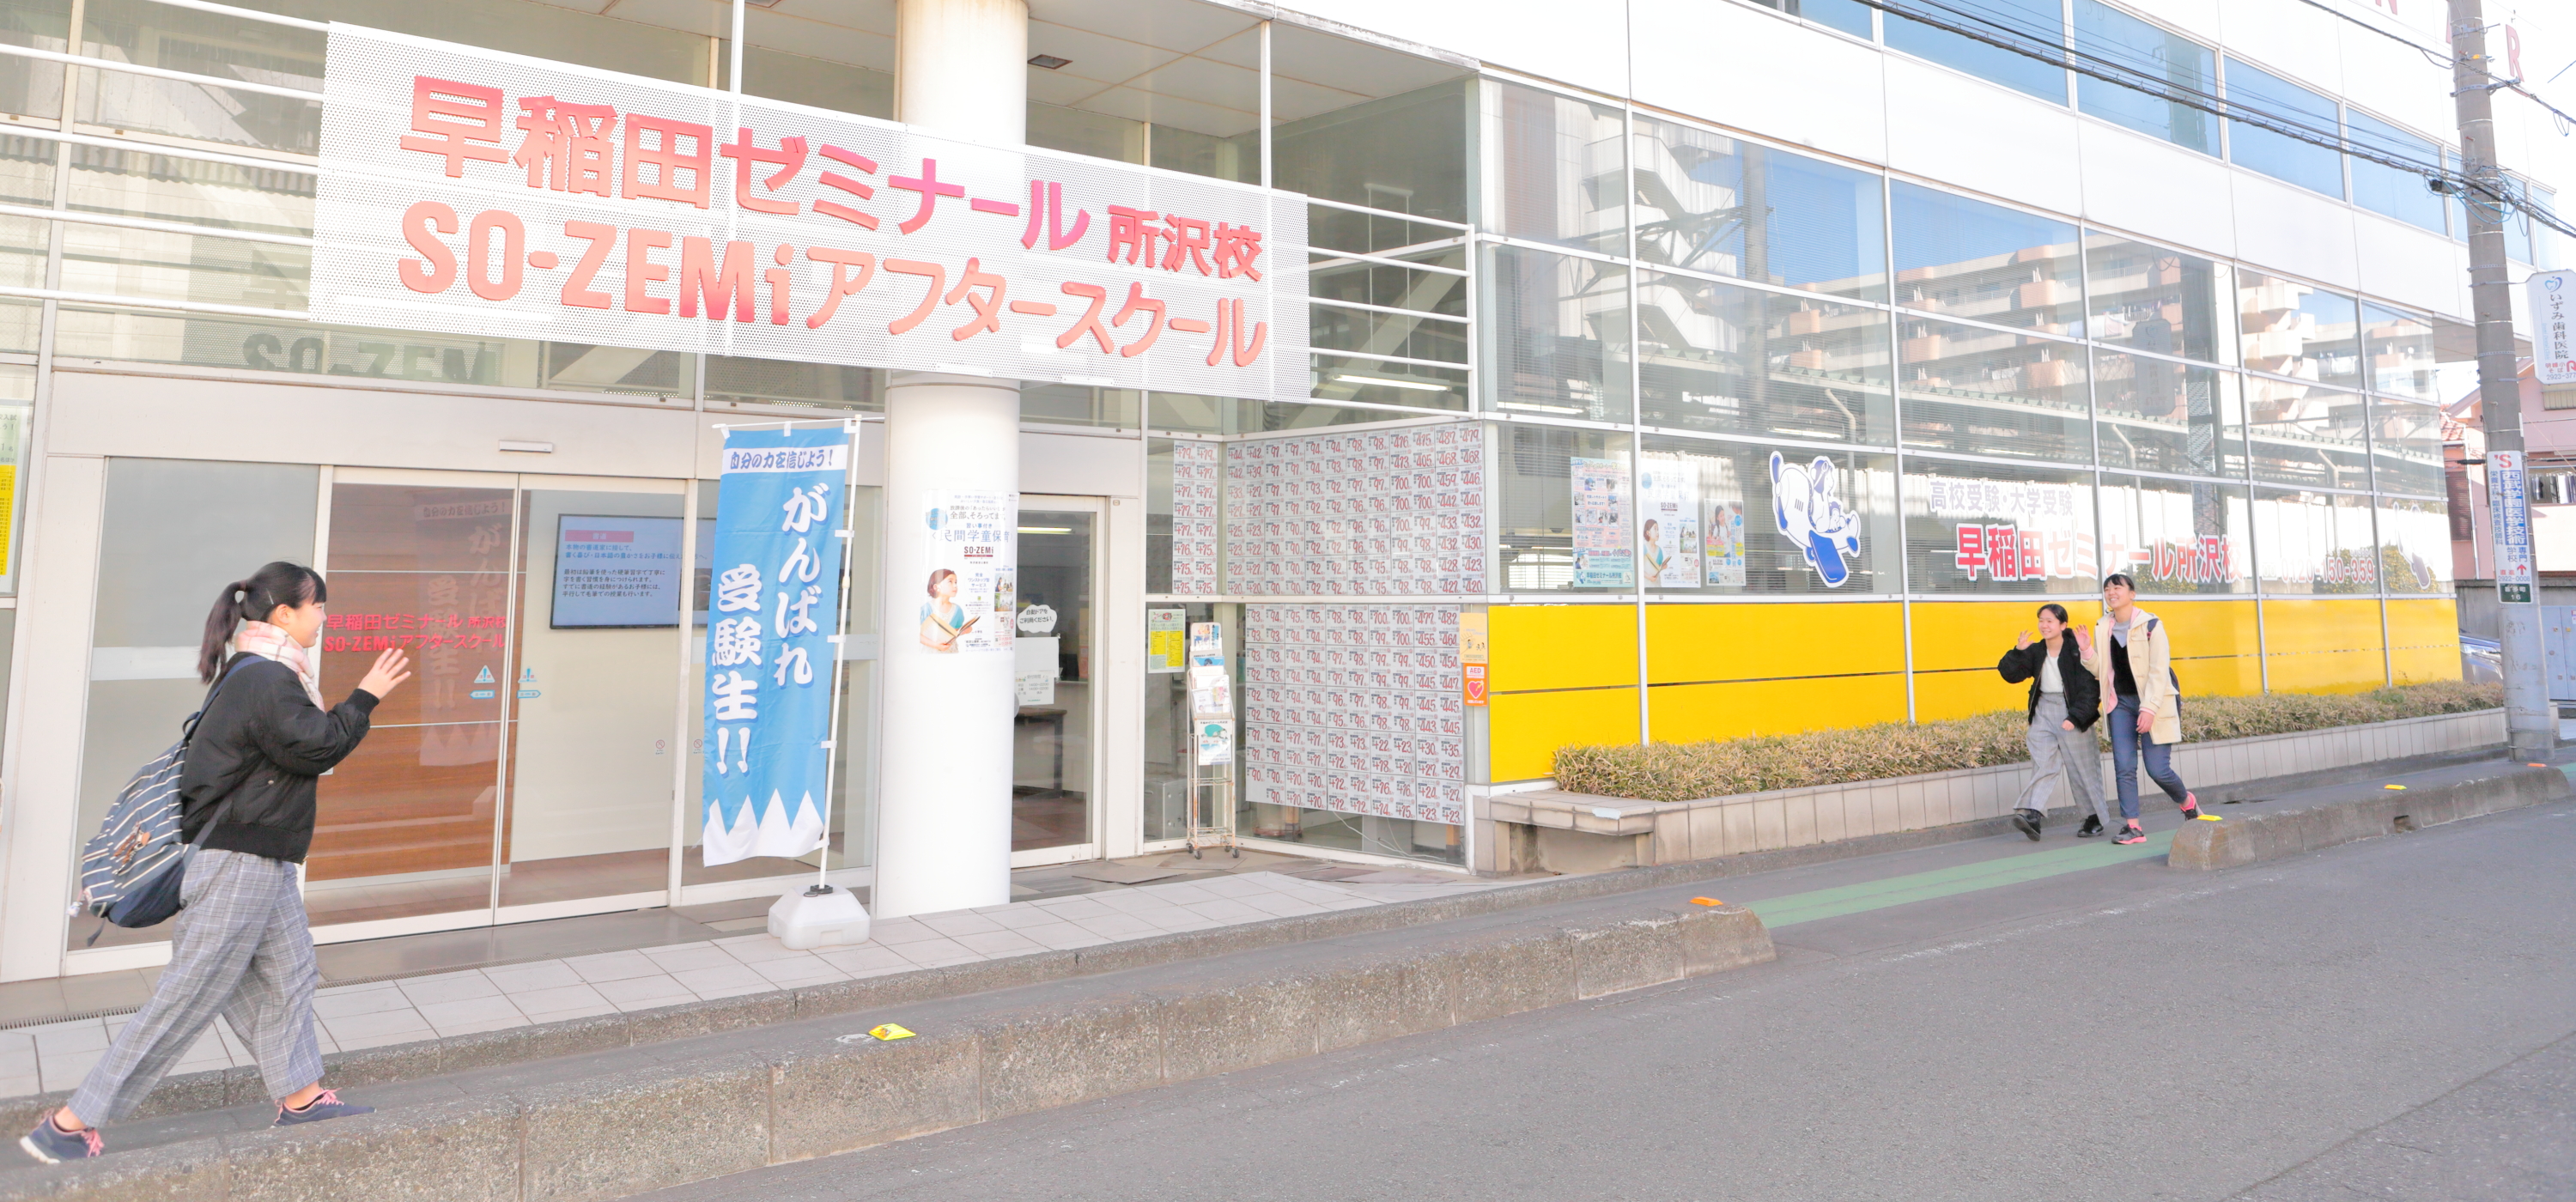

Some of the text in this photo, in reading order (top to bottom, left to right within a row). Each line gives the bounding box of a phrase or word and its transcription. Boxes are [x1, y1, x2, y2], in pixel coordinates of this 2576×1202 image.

[400, 76, 1262, 282] 早稲田ゼミナール 所沢校
[398, 201, 1267, 367] SO-ZEMiアフタースクール
[2550, 294, 2569, 360] いずみ歯科医院
[1930, 481, 2073, 516] 高校受験・大学受験
[964, 546, 994, 555] SO-ZEMi
[2282, 558, 2374, 583] 0120-150-359
[774, 483, 830, 687] がんばれ
[326, 613, 464, 631] 早稲田ゼミナール
